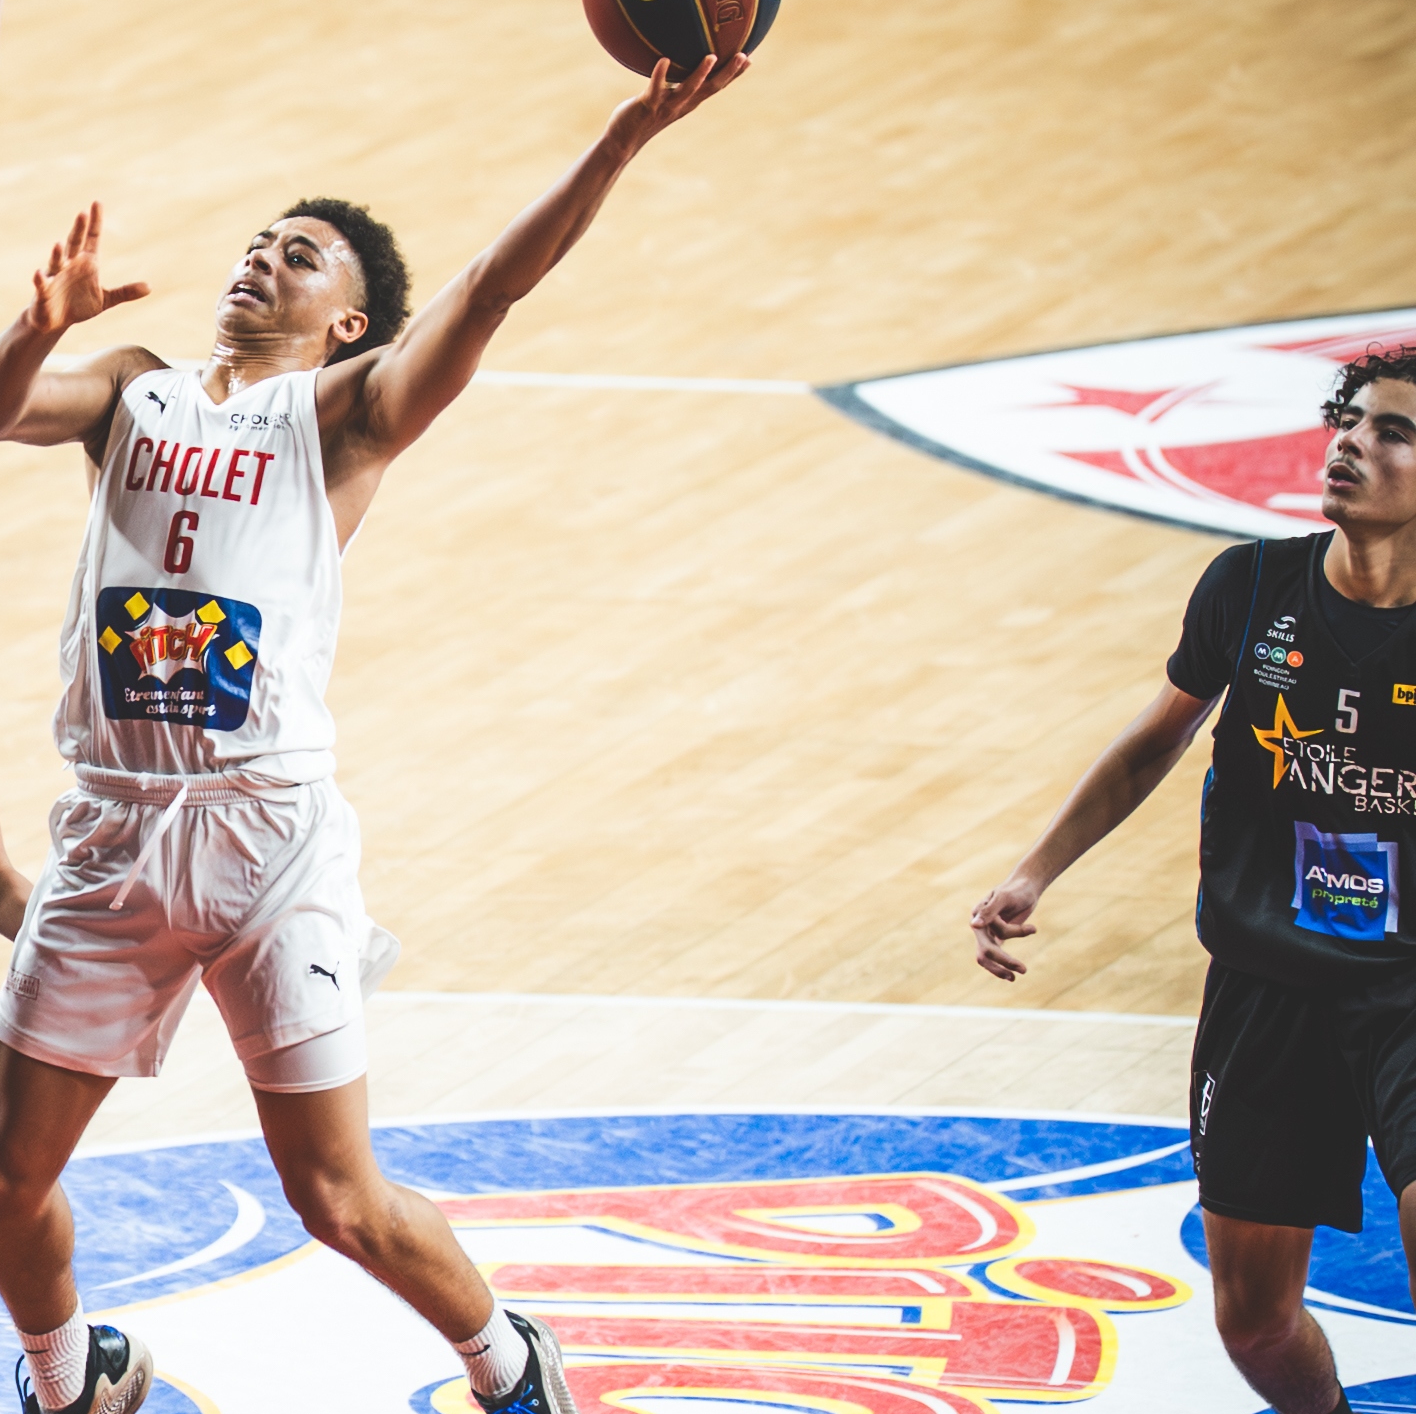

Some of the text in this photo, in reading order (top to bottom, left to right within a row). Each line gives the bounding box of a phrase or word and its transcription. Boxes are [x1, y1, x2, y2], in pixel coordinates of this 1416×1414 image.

[125, 437, 275, 506] CHOLET
[163, 509, 200, 574] 6
[1266, 628, 1295, 643] SKILLS
[1335, 688, 1361, 734] 5
[1284, 737, 1357, 764] ETOILE
[1354, 796, 1416, 816] BASK
[1304, 865, 1385, 894] AMOS
